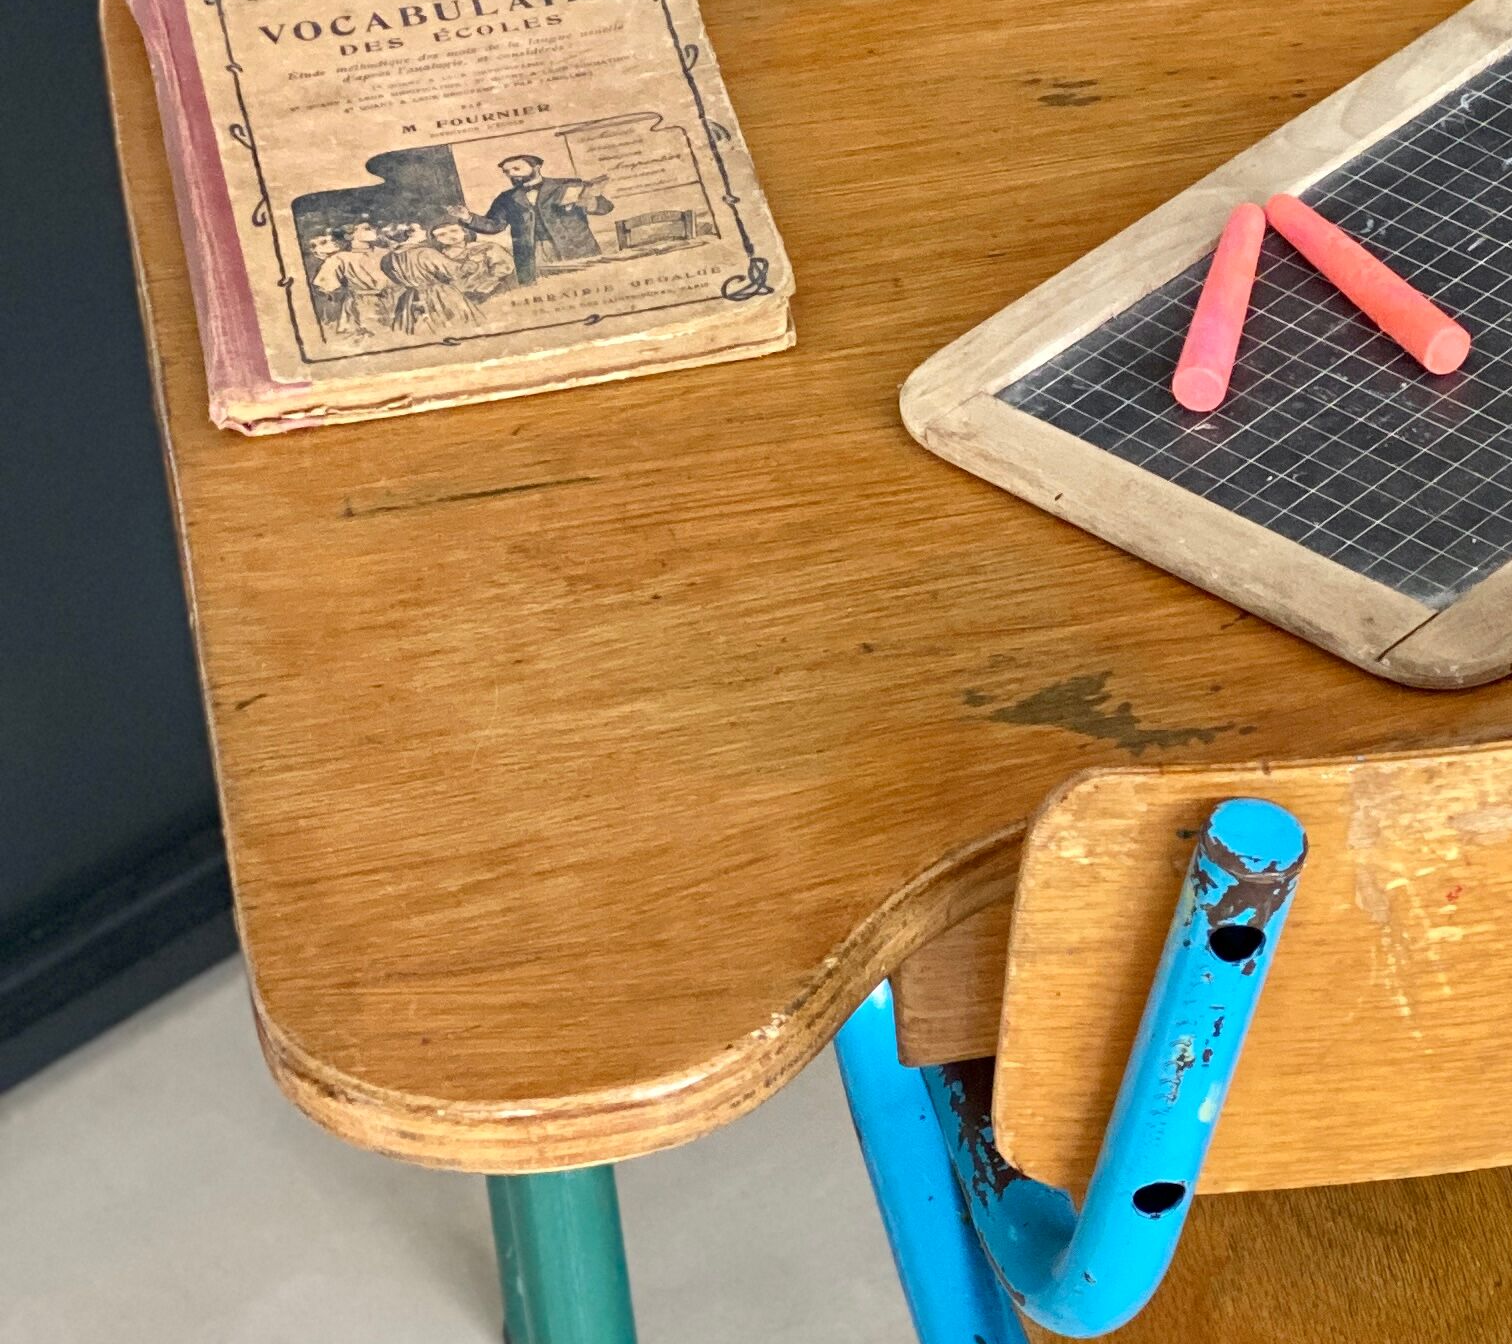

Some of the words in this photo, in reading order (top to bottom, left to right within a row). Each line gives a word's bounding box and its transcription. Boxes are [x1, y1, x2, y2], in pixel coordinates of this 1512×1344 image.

[339, 37, 404, 57] DES
[432, 14, 563, 43] ÉCOLES
[435, 103, 551, 129] FOURNIER
[511, 283, 615, 307] LIBRAIRIE
